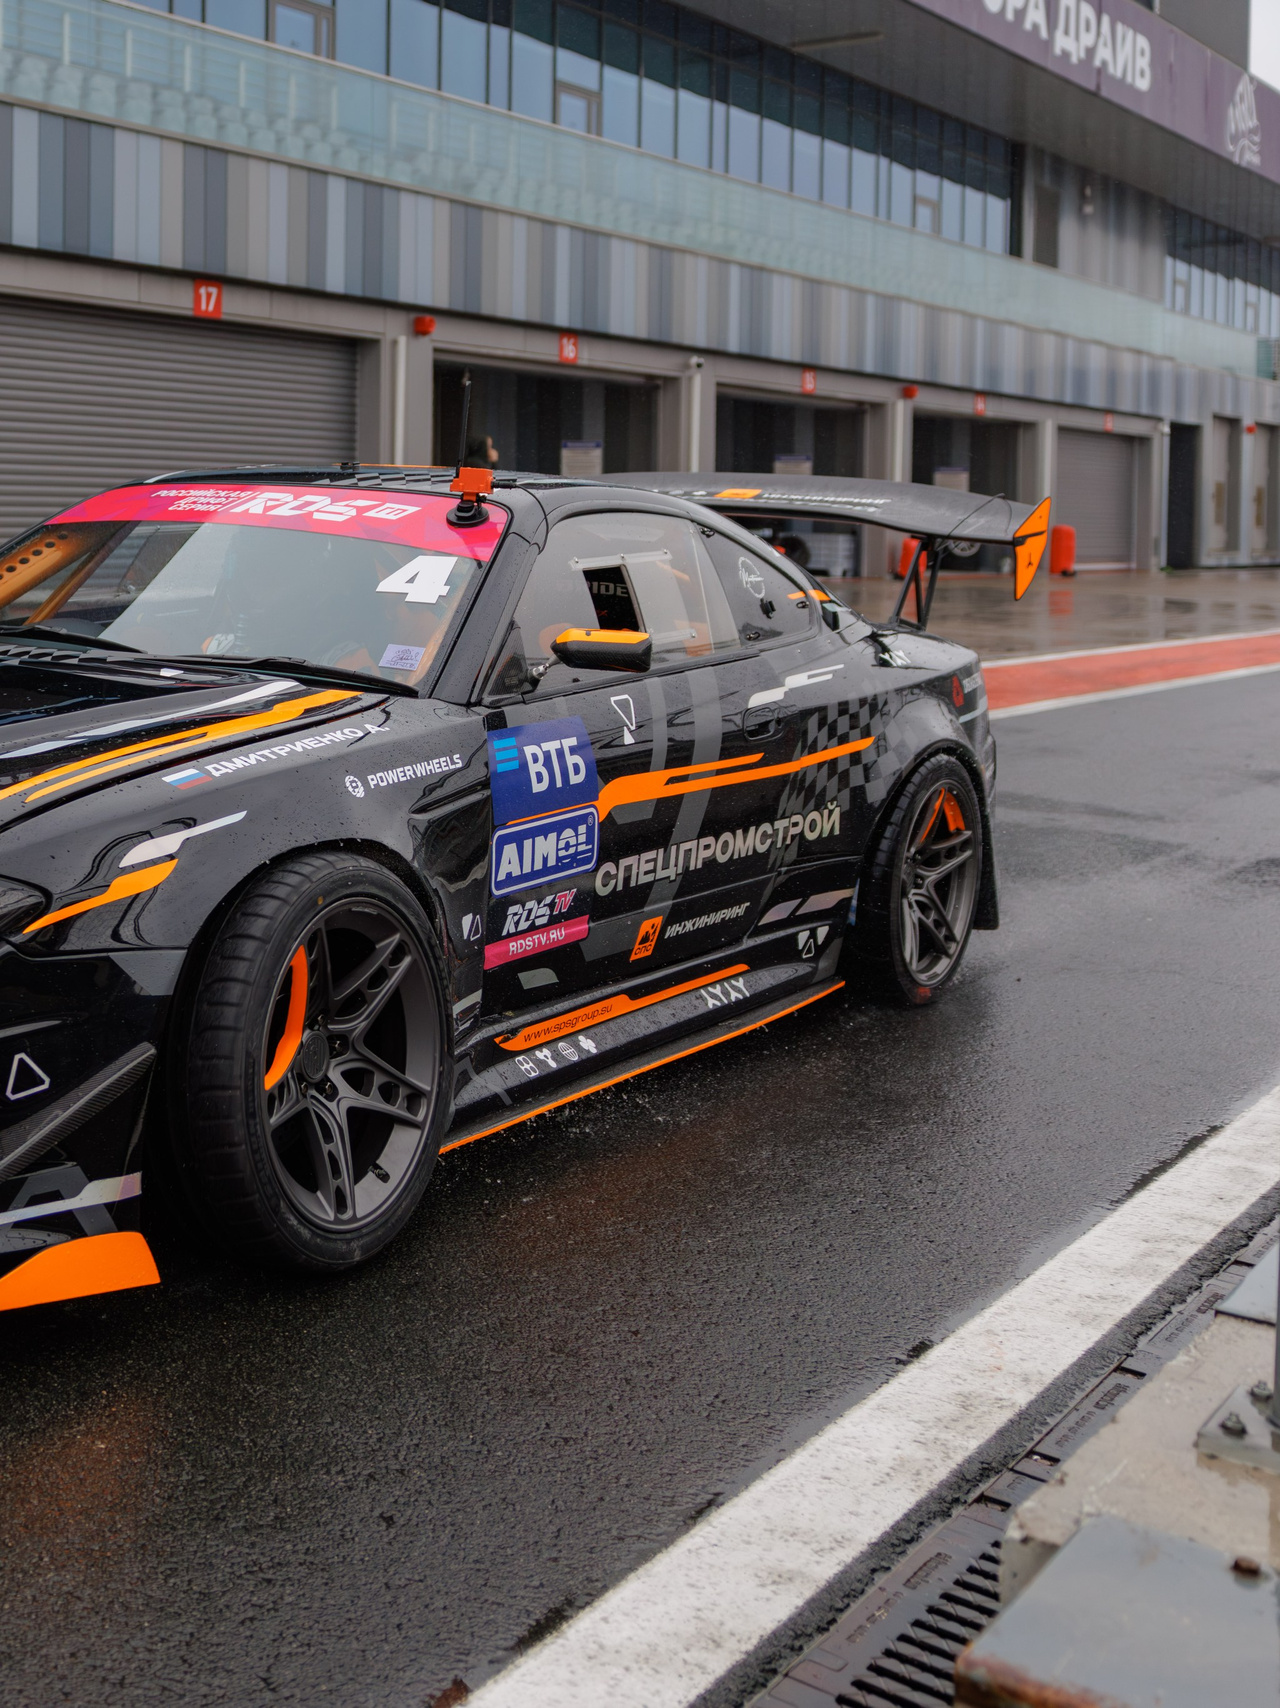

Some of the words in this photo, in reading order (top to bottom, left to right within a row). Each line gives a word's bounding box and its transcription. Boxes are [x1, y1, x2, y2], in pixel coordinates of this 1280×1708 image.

[198, 286, 218, 313] 17
[562, 336, 577, 359] 16
[229, 492, 382, 522] RDS
[375, 555, 459, 604] 4
[587, 581, 628, 597] IDE
[206, 727, 364, 779] ДМИТРИЕНКО
[367, 754, 463, 789] POWERWHEELS
[523, 736, 587, 794] ВТБ
[496, 824, 593, 882] AIMOL
[594, 801, 842, 897] СПЕЦПРОМСТРОЙ
[664, 902, 751, 939] ИНЖИНИРИНГ
[509, 927, 566, 956] RDSTV.RU
[523, 1004, 613, 1043] www.spsgroup.su
